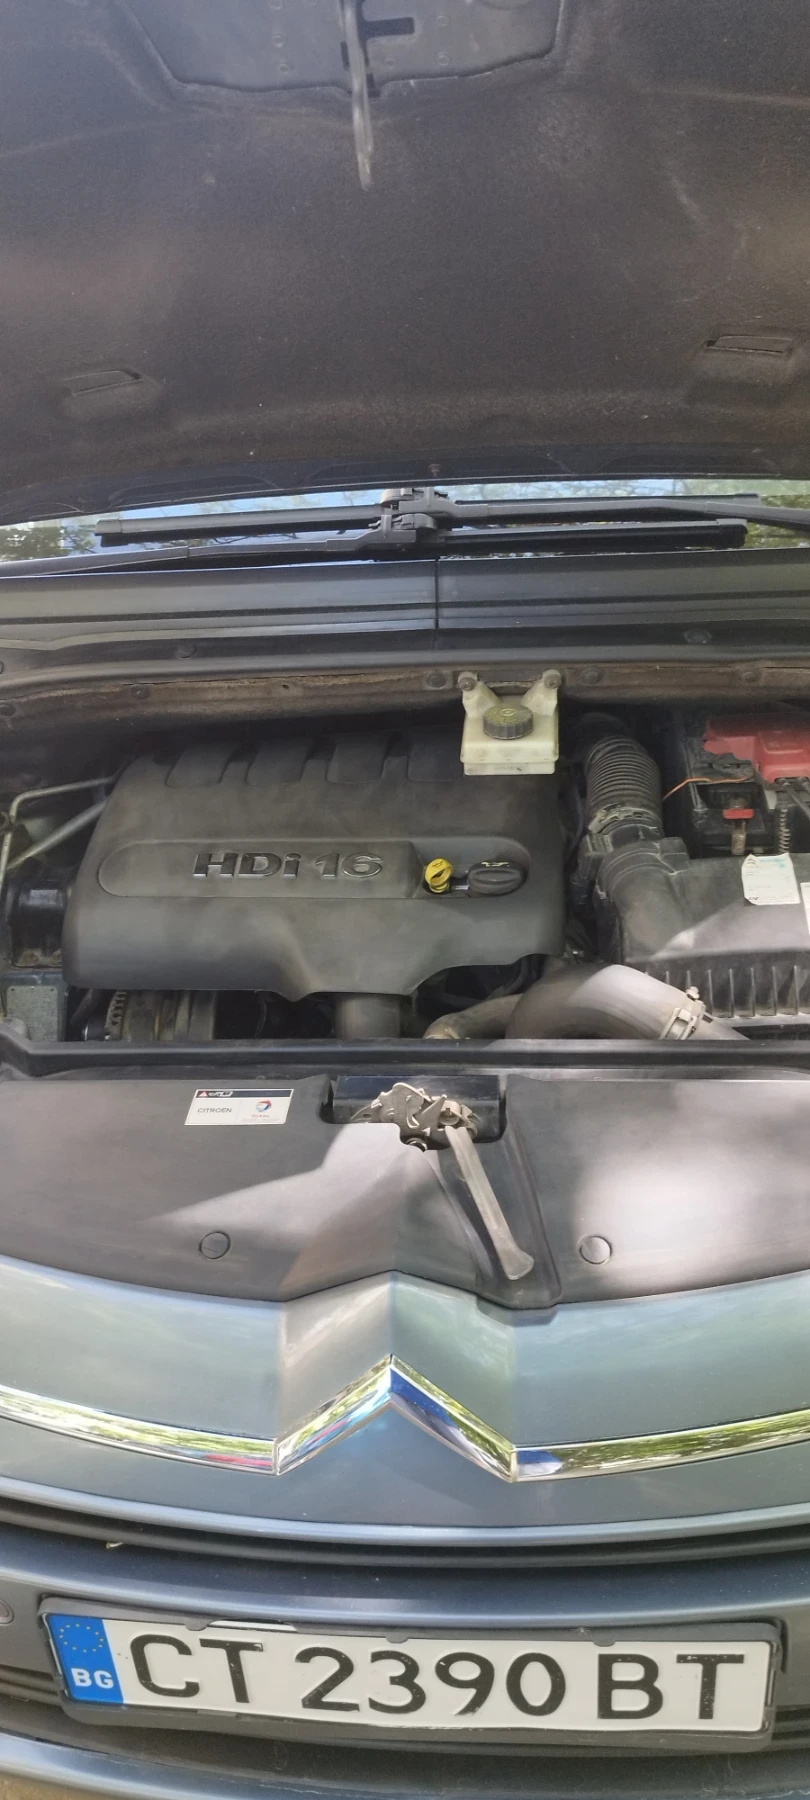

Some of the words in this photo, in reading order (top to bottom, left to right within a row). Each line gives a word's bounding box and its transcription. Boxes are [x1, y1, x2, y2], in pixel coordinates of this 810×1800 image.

[193, 851, 301, 878] HDi
[315, 852, 384, 878] 16
[72, 1667, 115, 1690] BG
[129, 1634, 264, 1704] CT
[294, 1647, 566, 1716] 2390
[598, 1653, 745, 1720] BT
